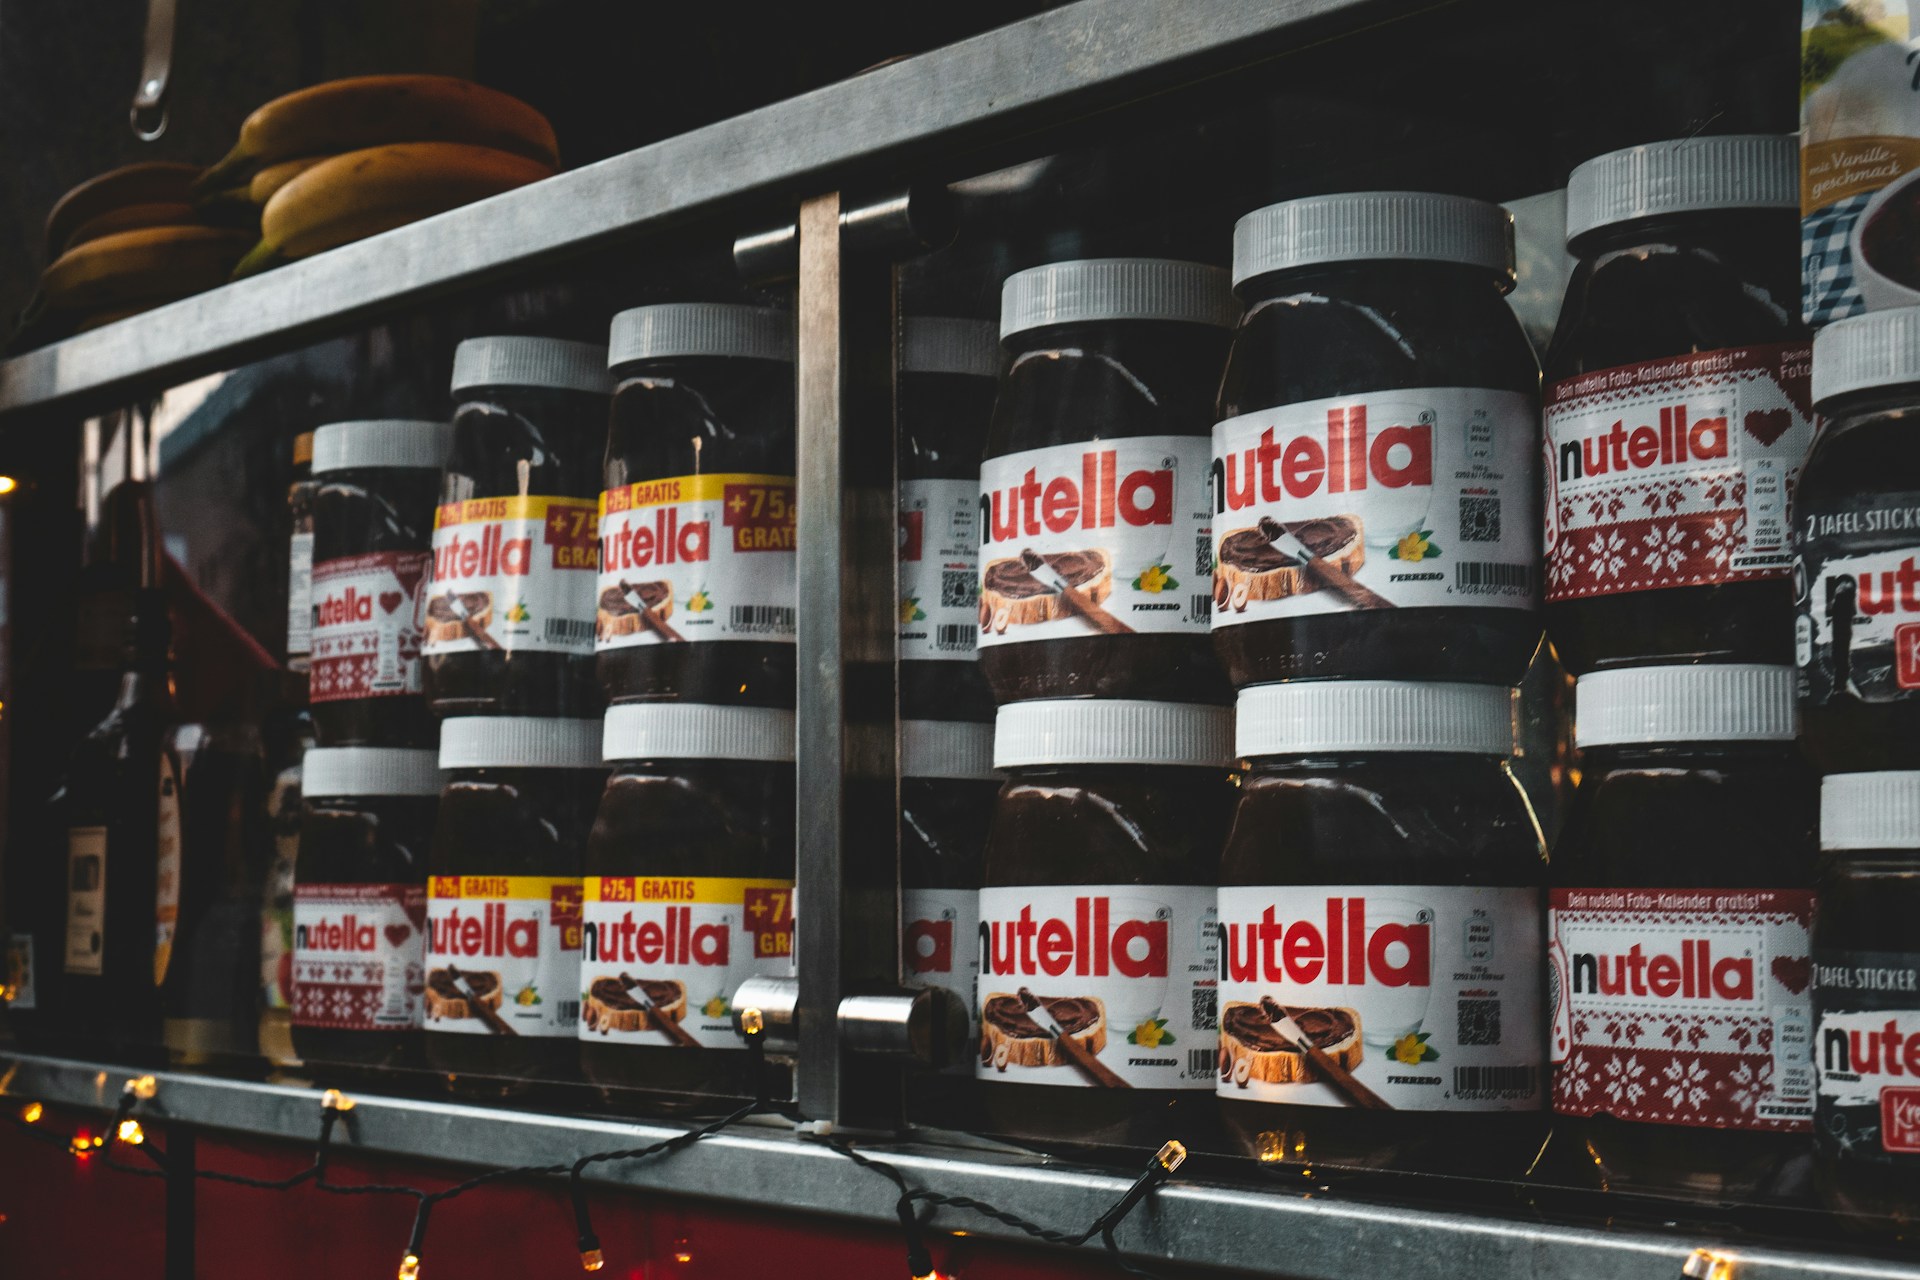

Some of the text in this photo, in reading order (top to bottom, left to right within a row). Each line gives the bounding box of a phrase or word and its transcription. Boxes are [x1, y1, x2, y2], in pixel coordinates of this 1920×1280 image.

[1809, 146, 1898, 176] mit Vanille-
[1811, 161, 1901, 199] geschmack
[1556, 384, 1573, 400] Dein
[1574, 375, 1608, 396] nutella
[1609, 361, 1688, 387] Foto-Kalender
[1560, 404, 1728, 482] nutella
[637, 481, 681, 506] GRATIS
[467, 500, 506, 520] GRATIS
[1806, 514, 1816, 542] 2
[1389, 572, 1444, 583] FERRERO
[1132, 603, 1181, 611] FERRERO
[465, 878, 508, 896] GRATIS
[642, 880, 695, 900] GRATIS
[1567, 891, 1588, 908] Dein
[1589, 893, 1624, 909] nutella
[1626, 893, 1711, 909] Foto-Kalender
[297, 915, 376, 951] nutella
[584, 906, 729, 966] nutella
[1573, 939, 1754, 1001] nutella
[1819, 965, 1917, 992] TAFEL-STICKER
[1128, 1058, 1178, 1067] FERRERO
[1386, 1075, 1442, 1085] FERRERO
